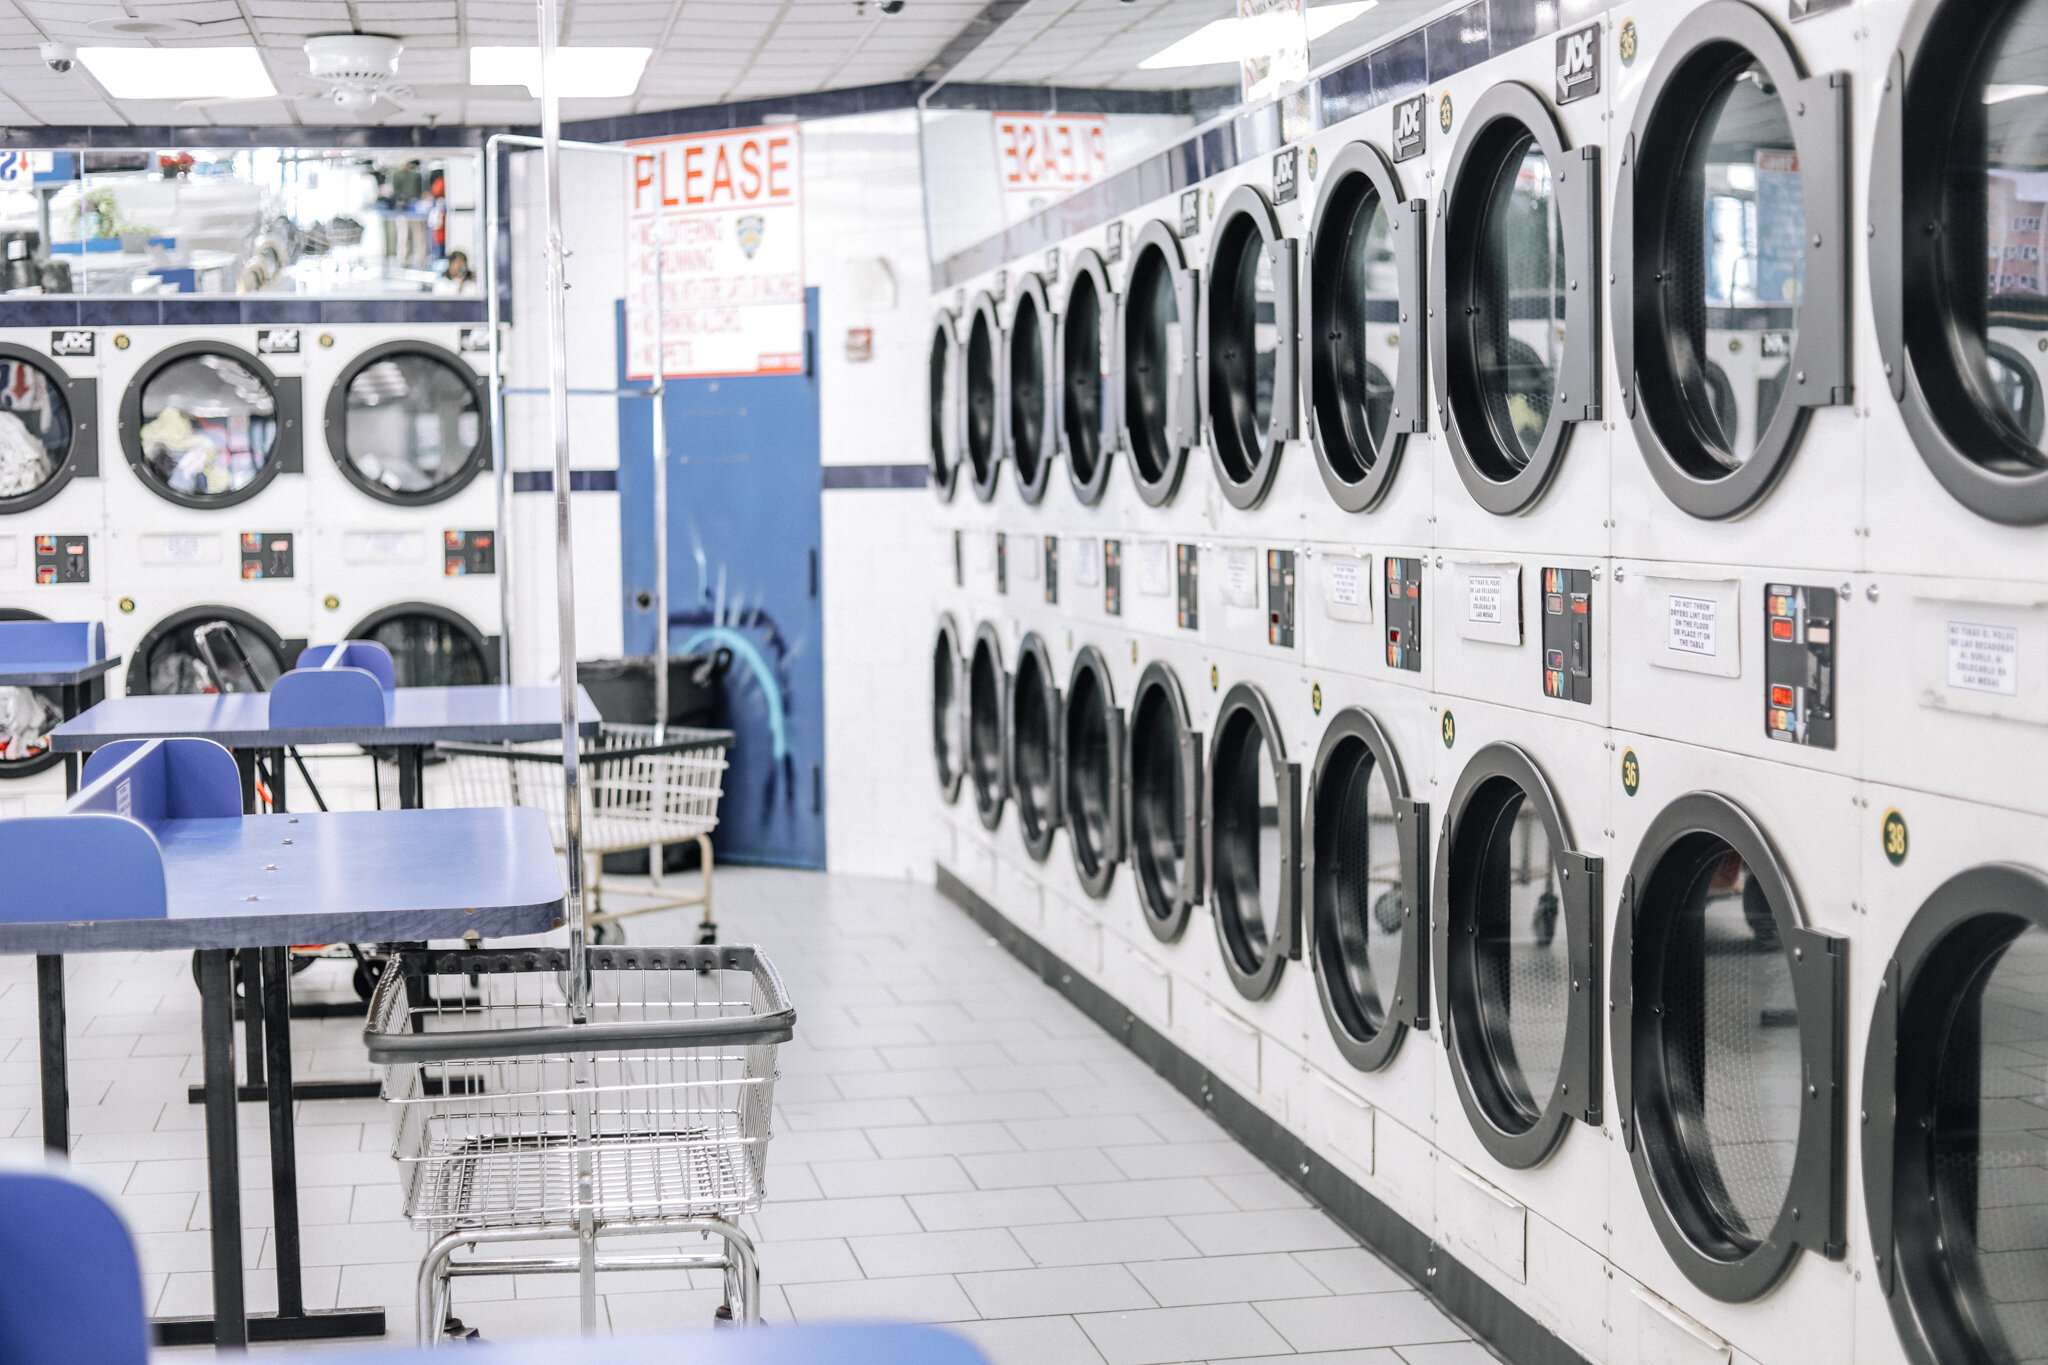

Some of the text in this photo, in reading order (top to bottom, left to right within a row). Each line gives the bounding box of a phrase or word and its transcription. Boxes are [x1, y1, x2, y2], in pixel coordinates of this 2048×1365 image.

[635, 138, 790, 209] PLEASE
[1682, 601, 1693, 609] NOT
[1694, 602, 1710, 611] THROW
[1444, 718, 1453, 741] 34
[1625, 760, 1637, 787] 36
[1888, 821, 1905, 855] 38
